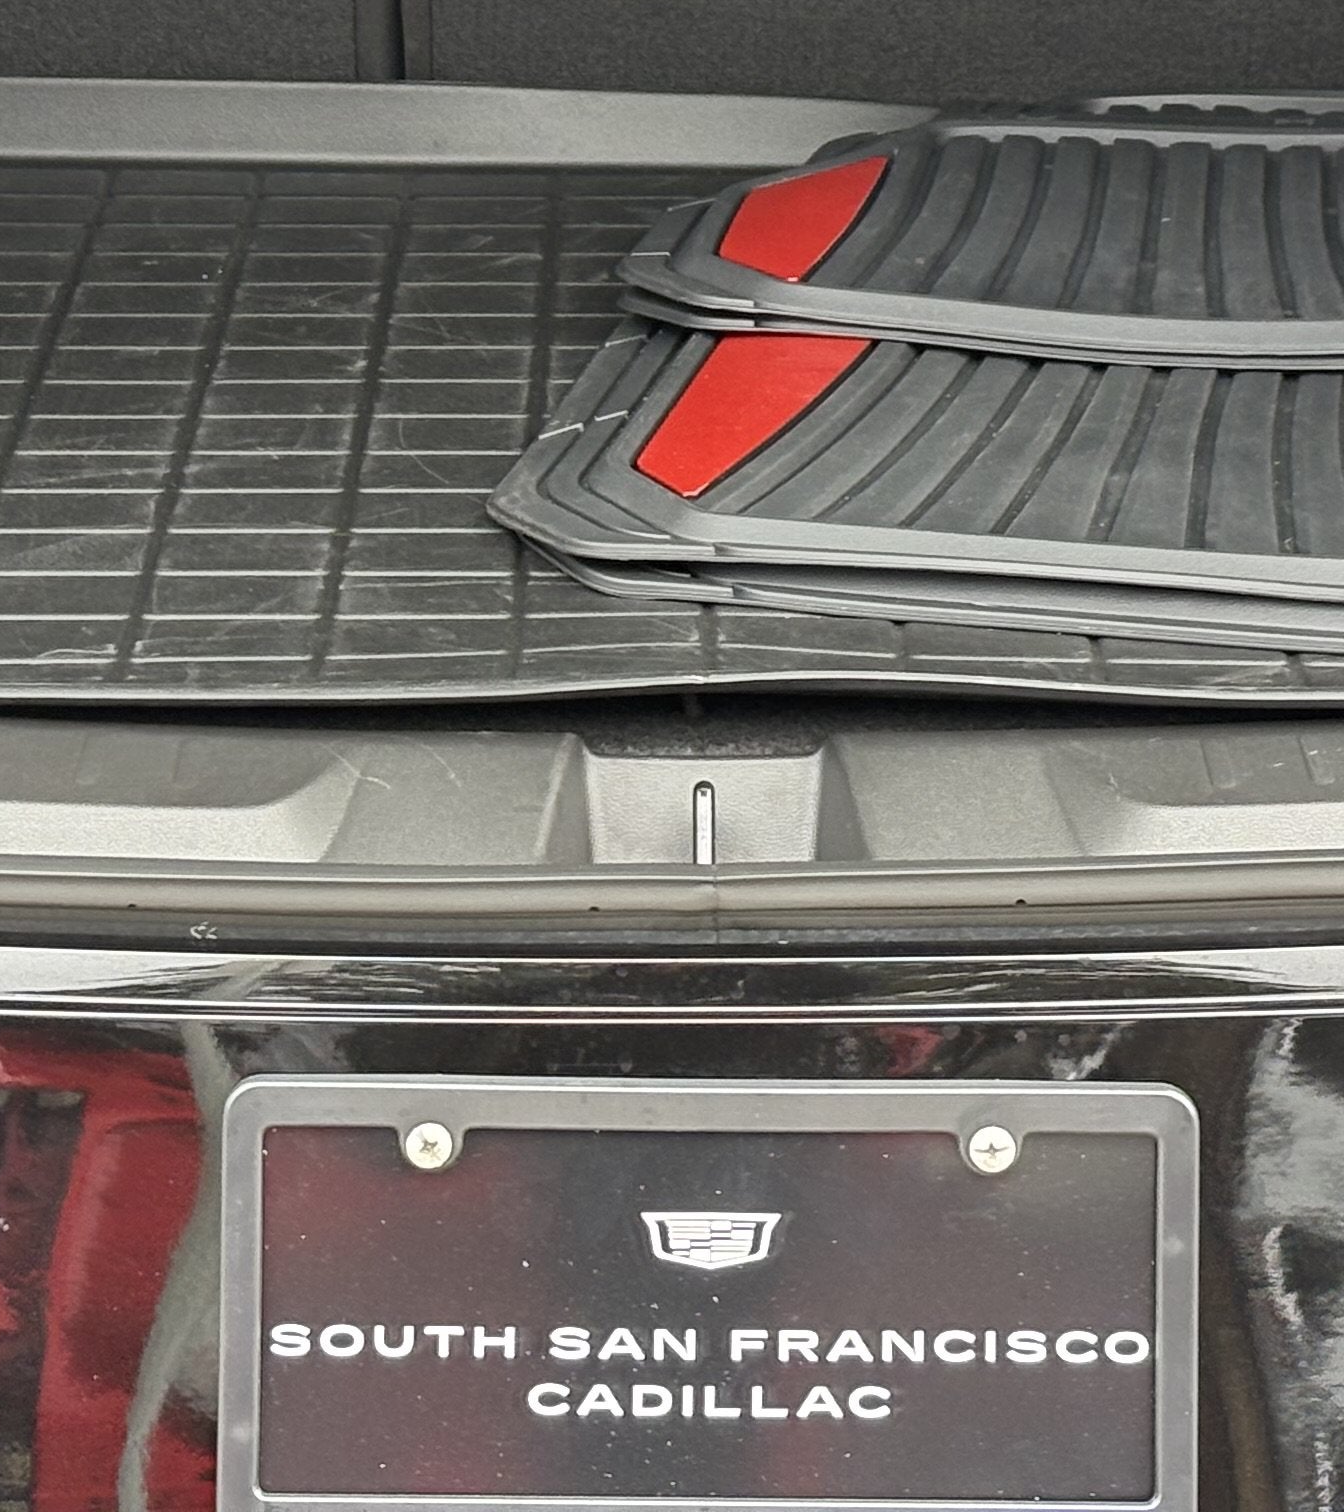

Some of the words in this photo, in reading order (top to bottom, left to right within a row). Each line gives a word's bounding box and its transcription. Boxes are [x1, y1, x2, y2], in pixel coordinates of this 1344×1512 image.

[269, 1323, 516, 1360] SOUTH
[548, 1326, 697, 1362] SAN
[730, 1329, 1150, 1365] FRANCISCO
[527, 1382, 891, 1420] CADILLAC
